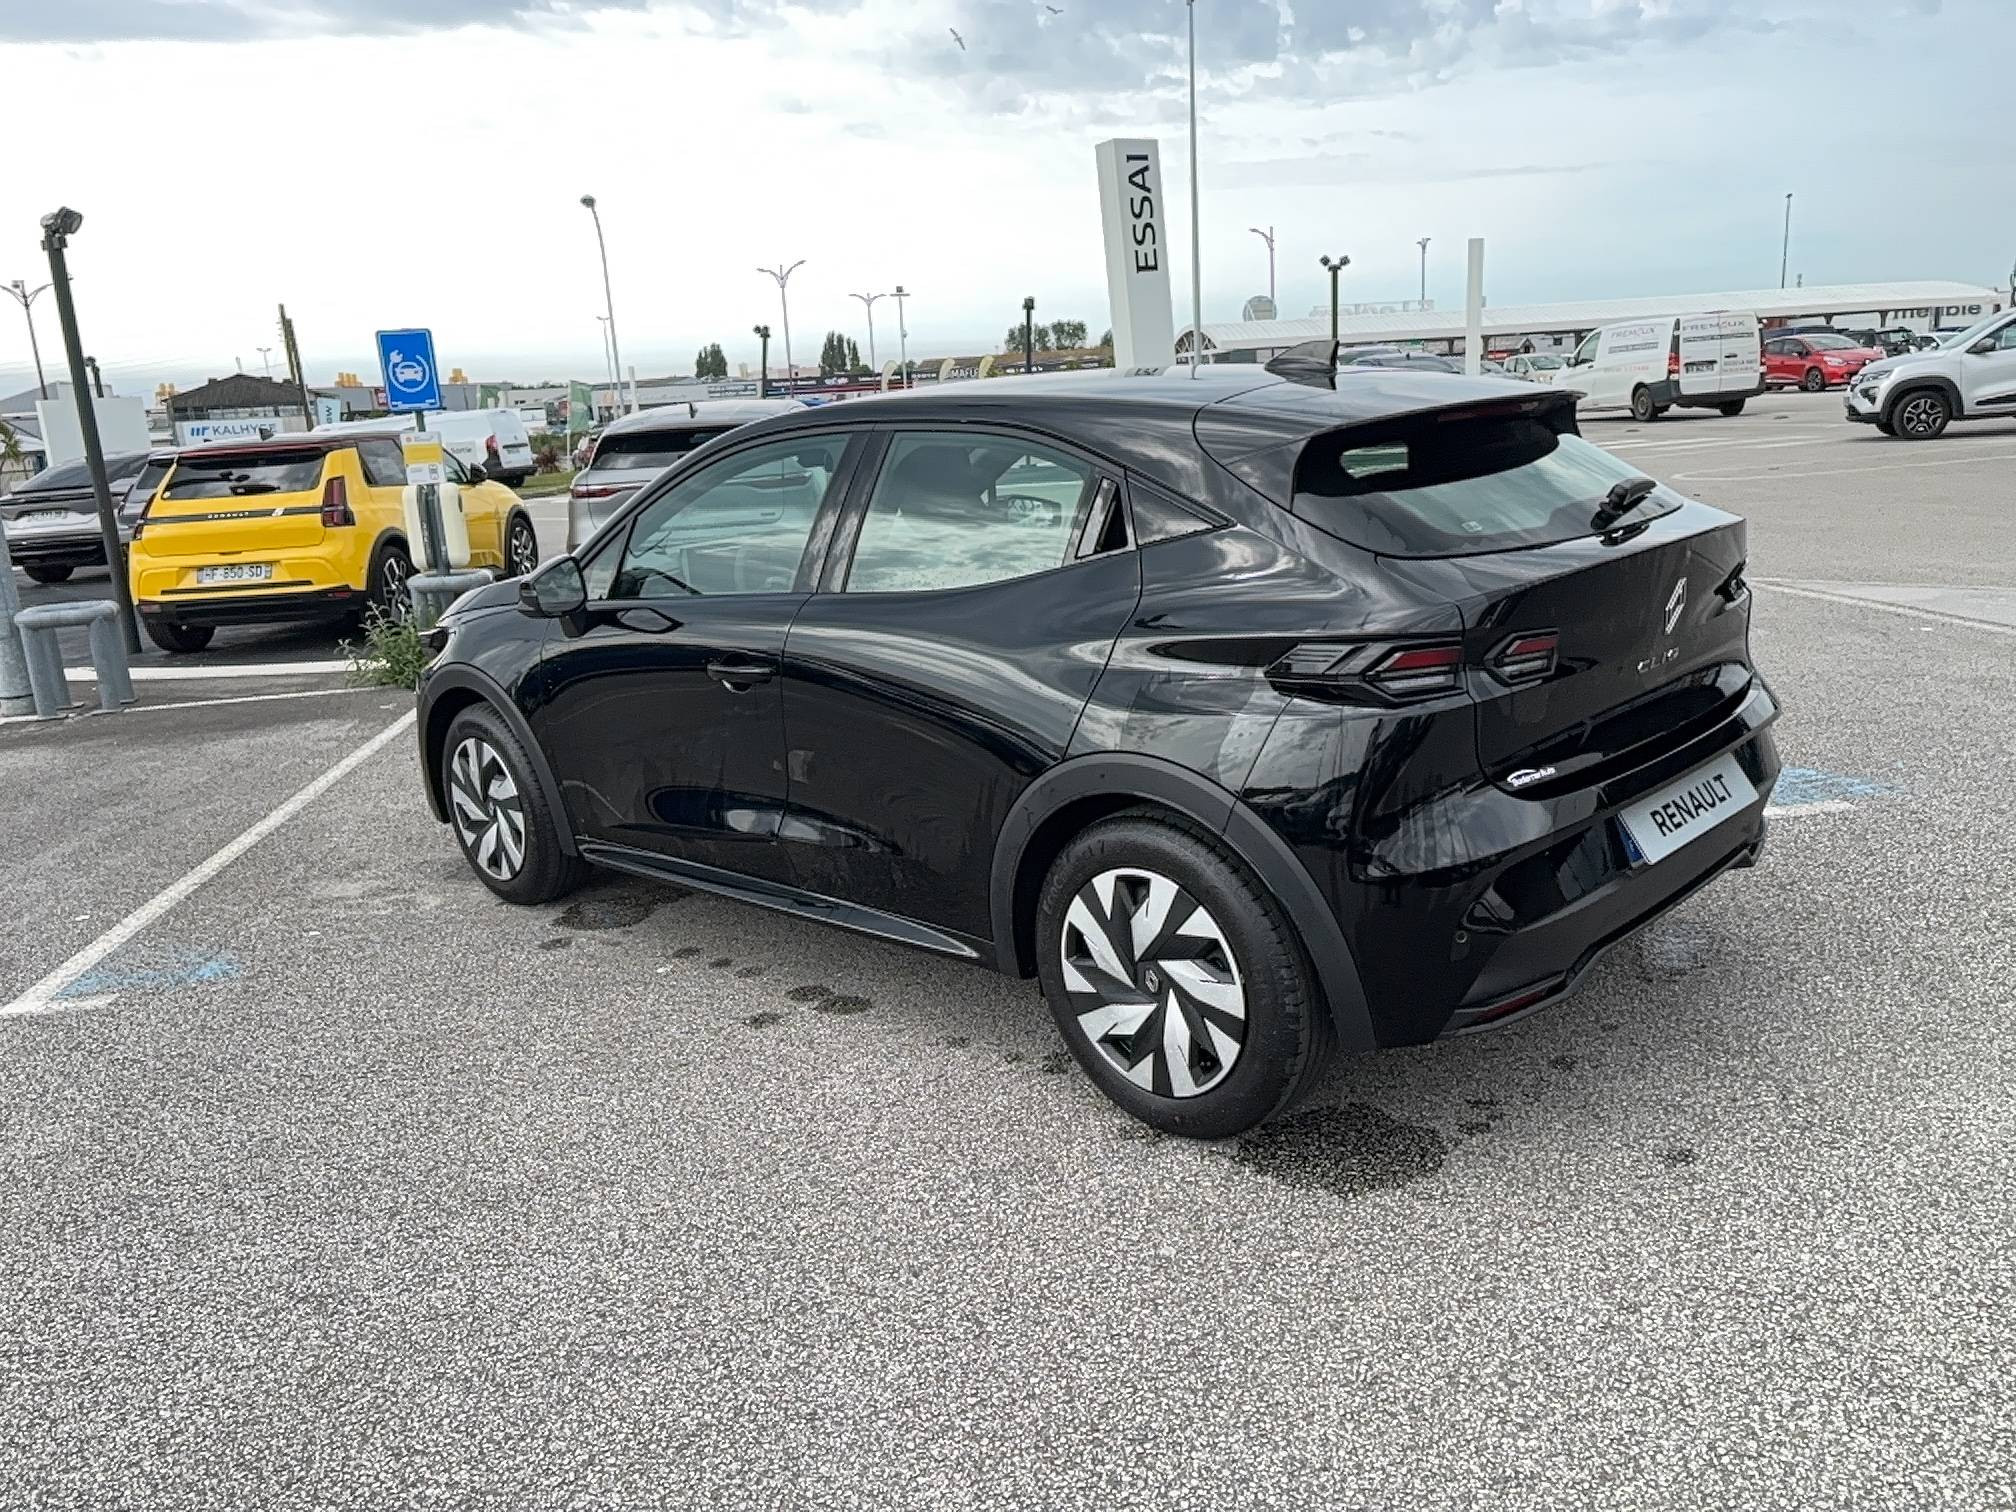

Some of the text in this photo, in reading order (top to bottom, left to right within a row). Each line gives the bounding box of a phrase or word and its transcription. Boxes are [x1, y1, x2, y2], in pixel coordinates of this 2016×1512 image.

[1126, 153, 1159, 274] ESSAI
[1636, 646, 1680, 673] CLIO
[1649, 773, 1733, 837] RENAULT
